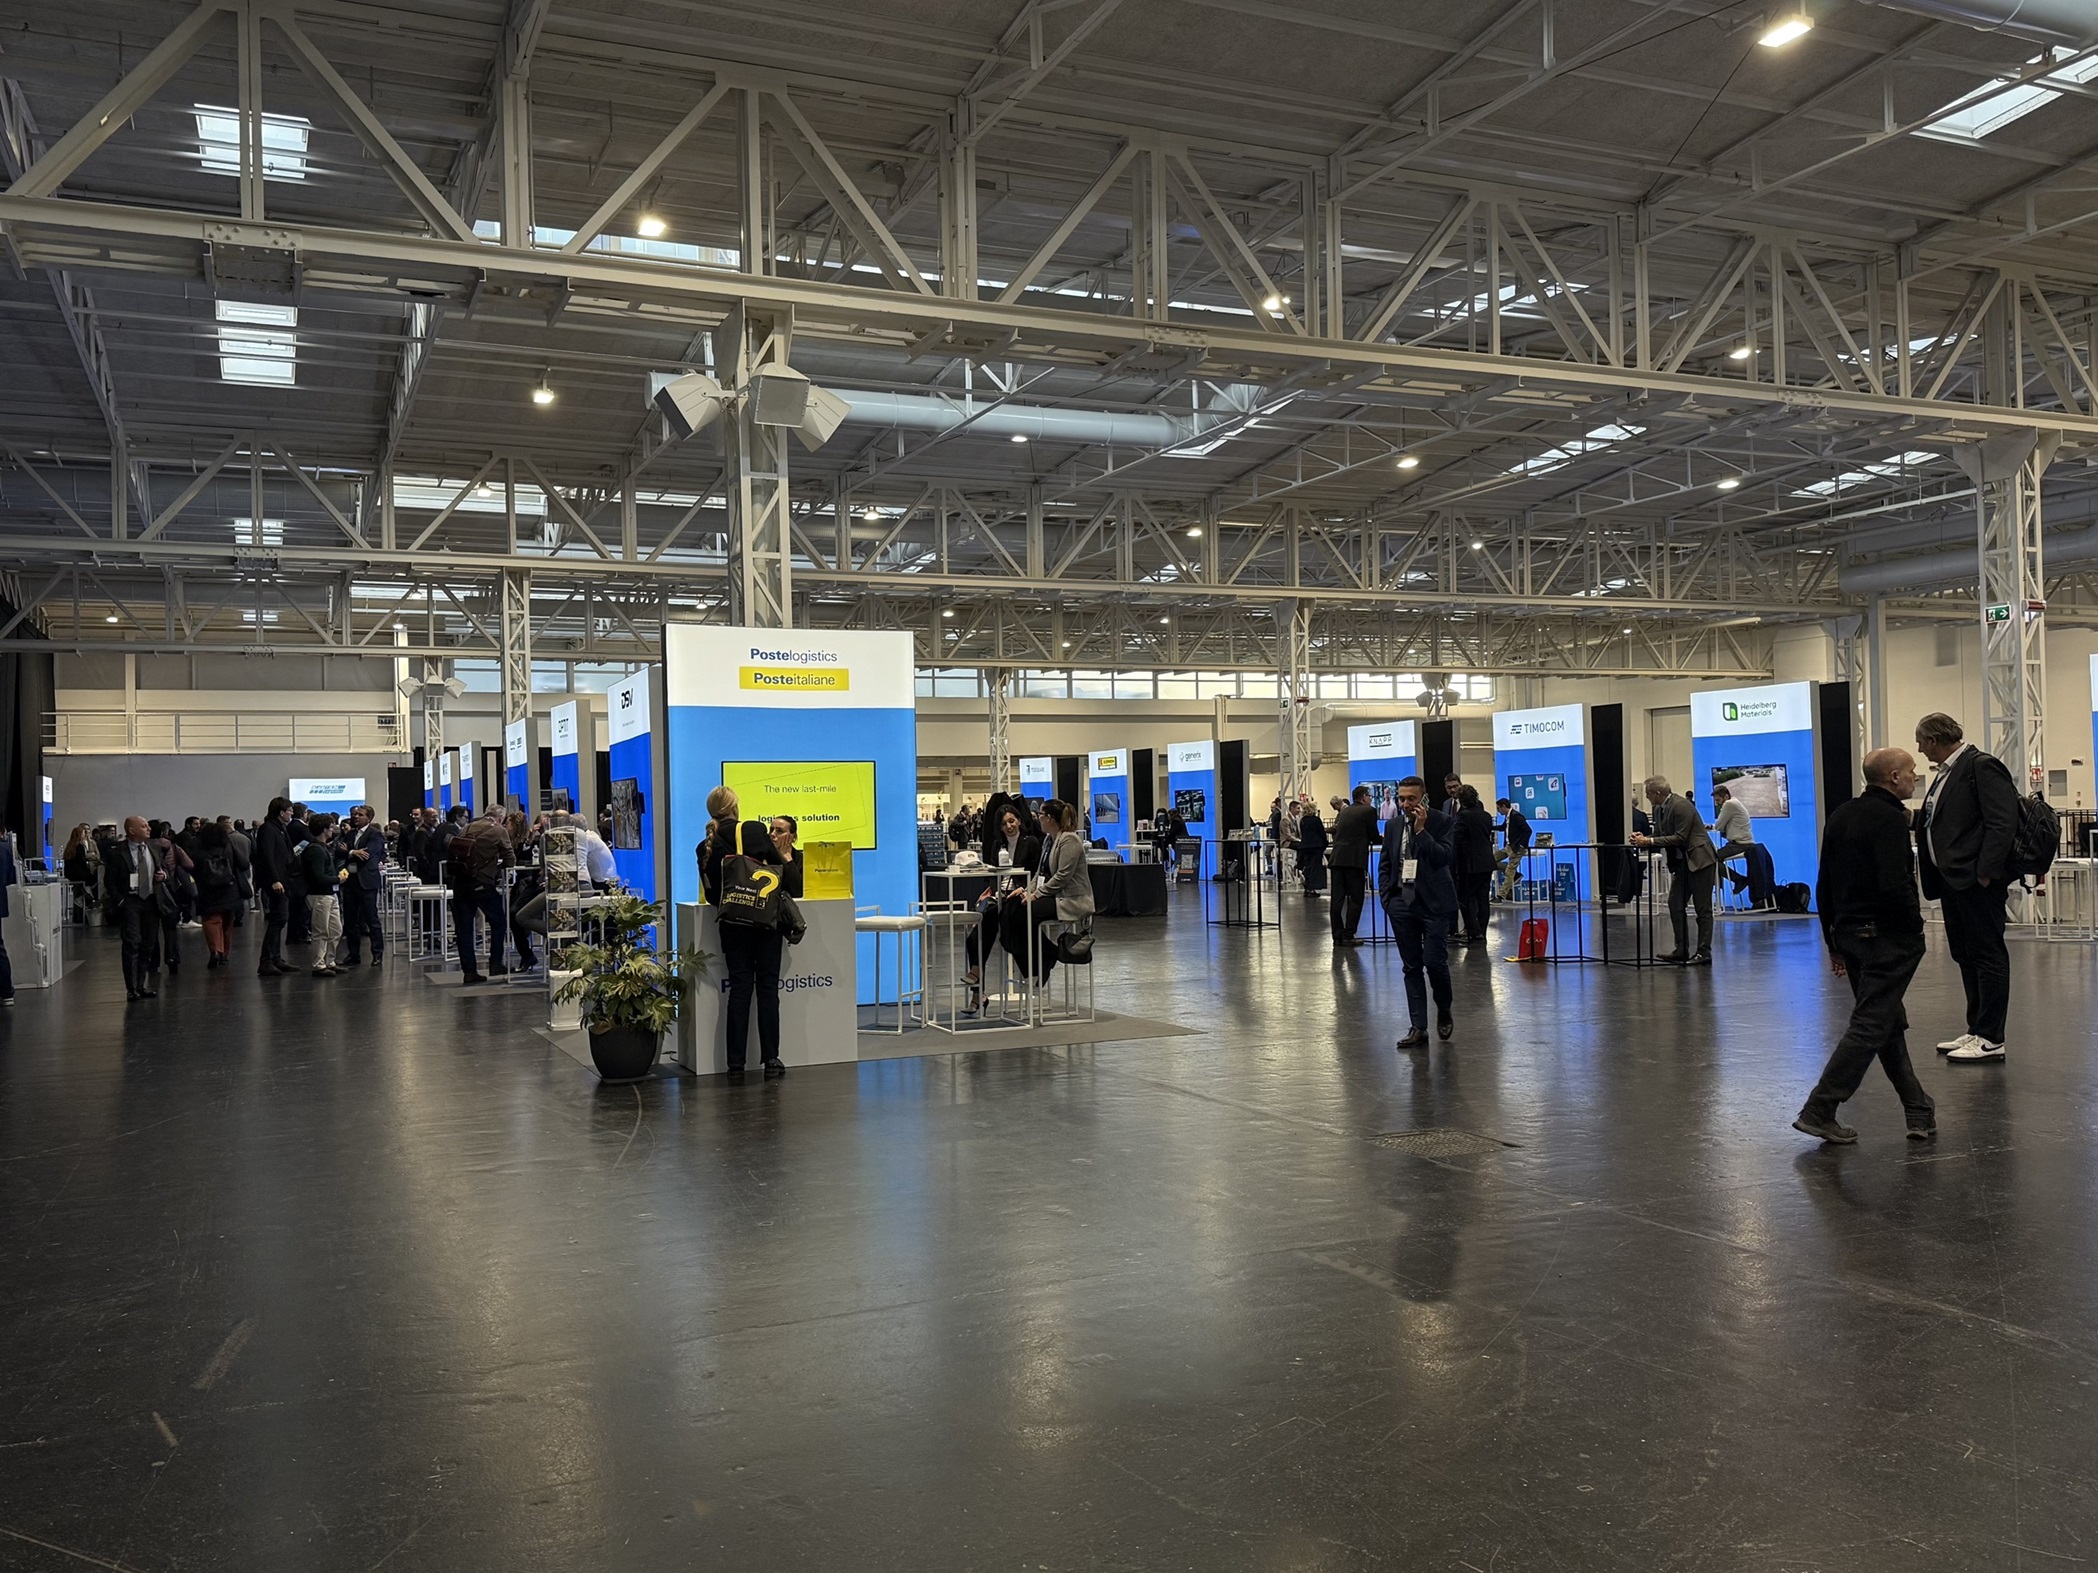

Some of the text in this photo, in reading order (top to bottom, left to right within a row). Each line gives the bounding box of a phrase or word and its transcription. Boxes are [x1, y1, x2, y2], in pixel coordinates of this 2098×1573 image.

[750, 648, 838, 664] Postelogistics
[754, 672, 835, 685] Posteitaliane
[1740, 702, 1777, 710] Heidelberg
[1740, 710, 1772, 718] Materials
[1524, 720, 1564, 734] TIMOCOM
[764, 784, 837, 793] The new last-mile
[802, 813, 840, 822] solution
[727, 892, 756, 902] LOGISTICS
[722, 898, 755, 907] CHALLENGE
[721, 973, 833, 993] Pogistics
